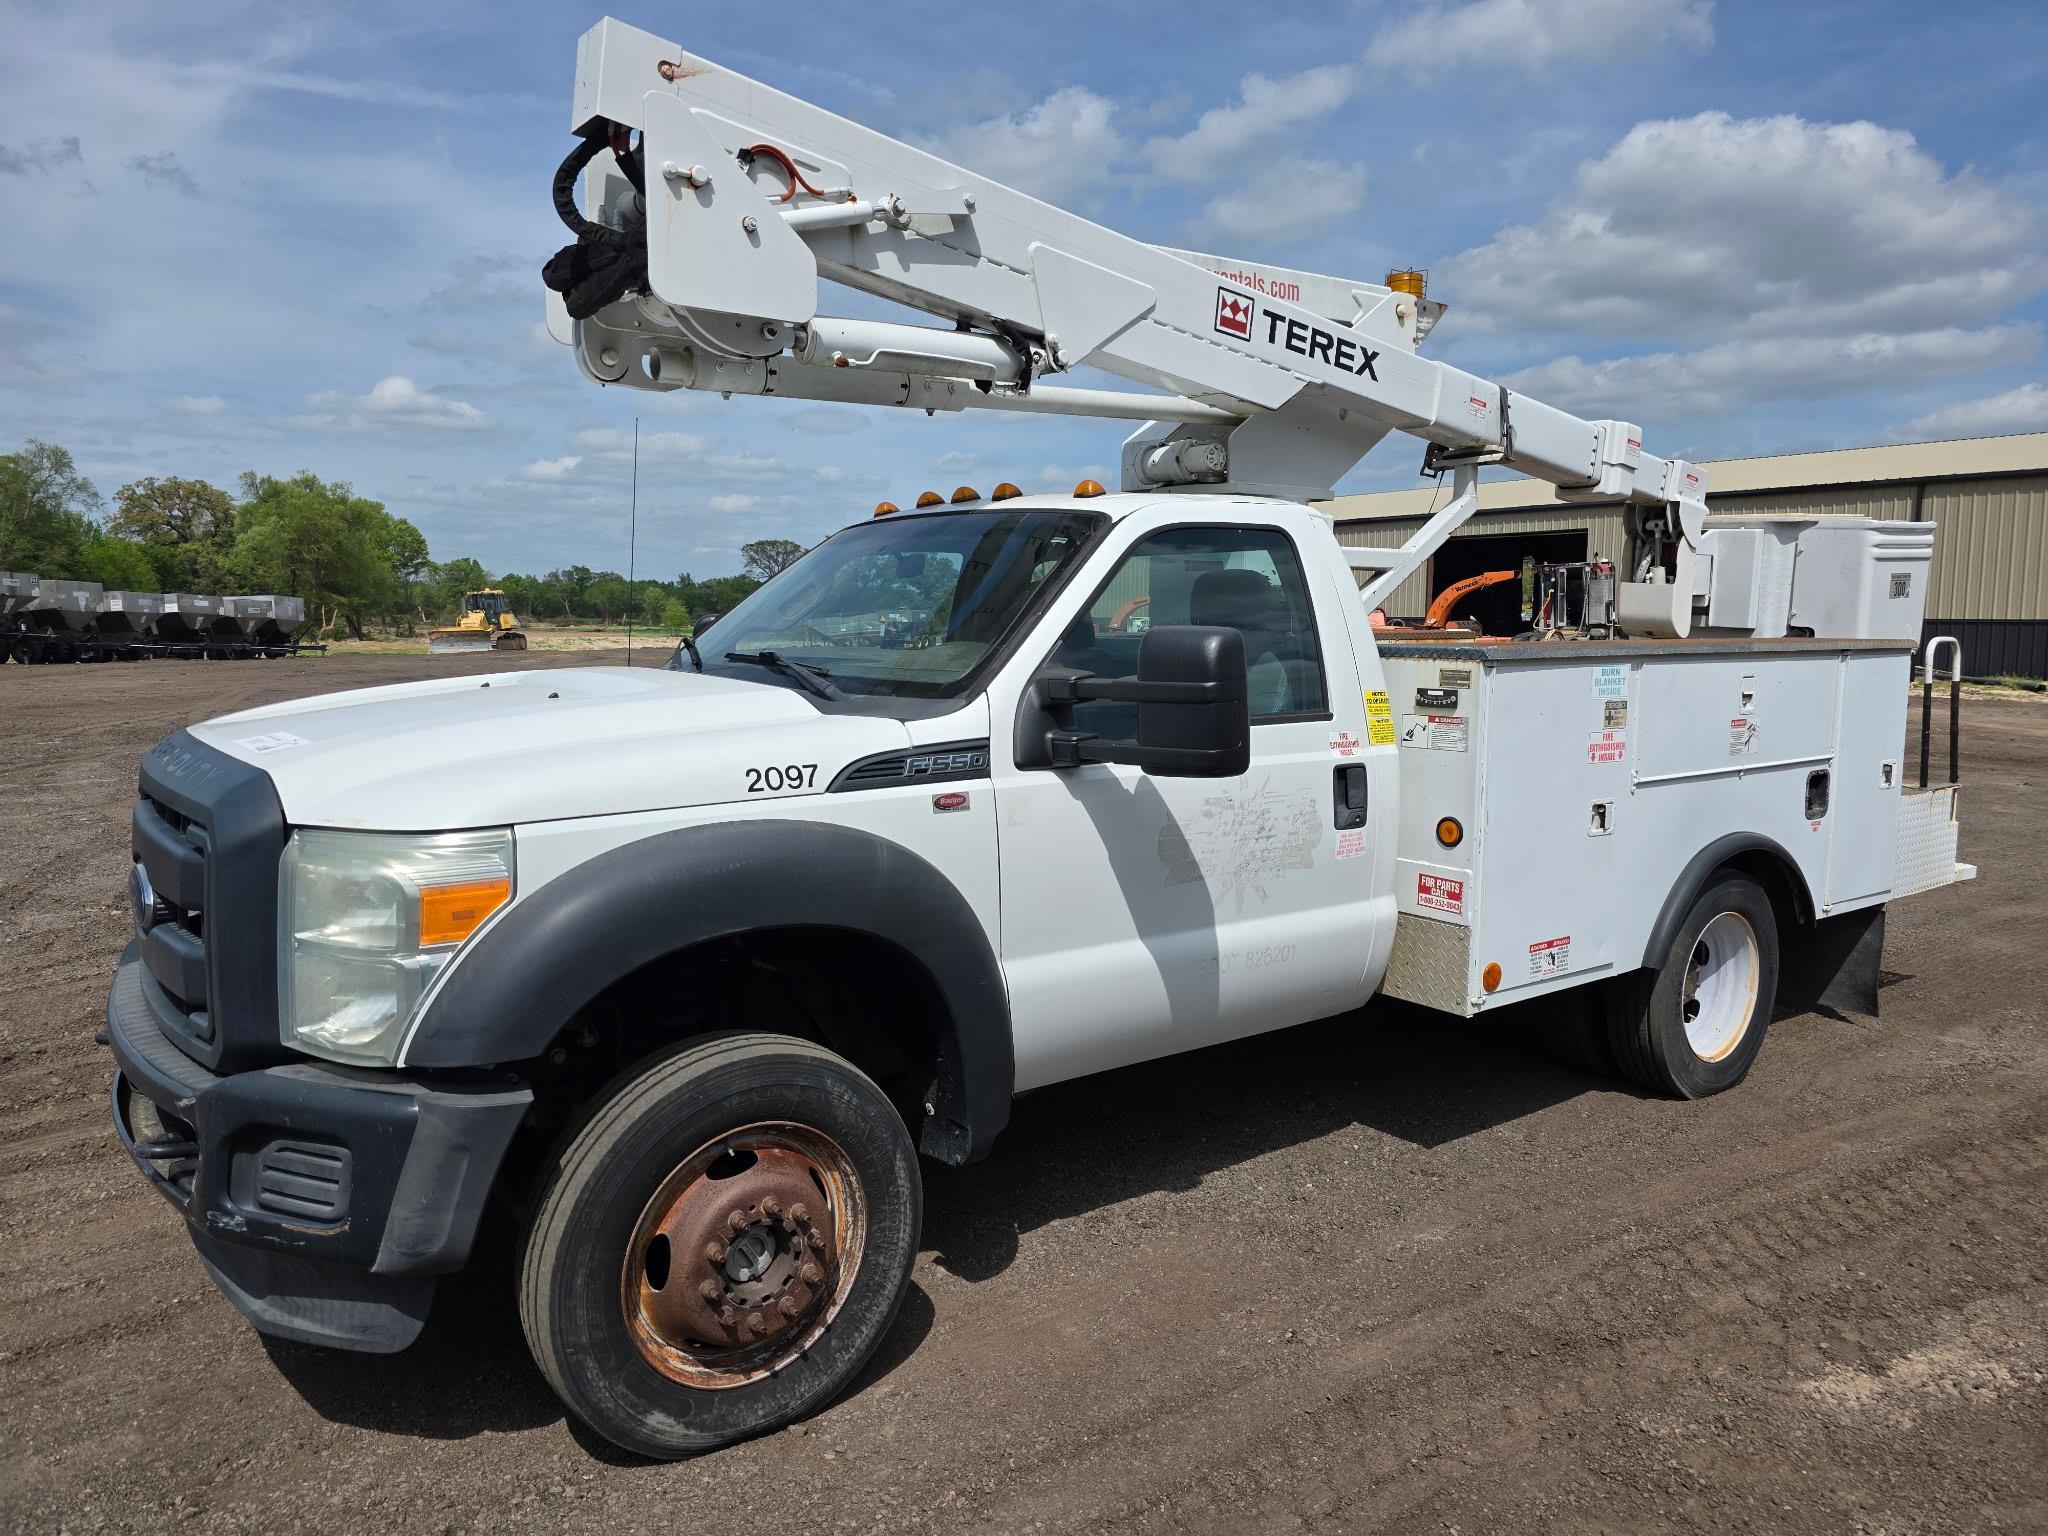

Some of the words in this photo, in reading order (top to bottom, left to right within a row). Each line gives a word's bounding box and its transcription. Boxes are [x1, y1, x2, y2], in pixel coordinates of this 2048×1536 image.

[1262, 309, 1381, 383] TEREX
[1601, 668, 1620, 677] BURN
[1594, 677, 1627, 687] BLANKET
[1598, 687, 1621, 696] INSIDE
[1602, 732, 1614, 742] FIRE
[1589, 742, 1626, 753] EXTINGUISHER
[1598, 752, 1616, 761] INSIDE
[745, 763, 818, 793] 2097
[940, 795, 964, 805] Badger
[1421, 875, 1435, 888] FOR
[1436, 879, 1460, 894] PARTS
[1431, 887, 1449, 899] CALL
[1245, 944, 1296, 969] 826201
